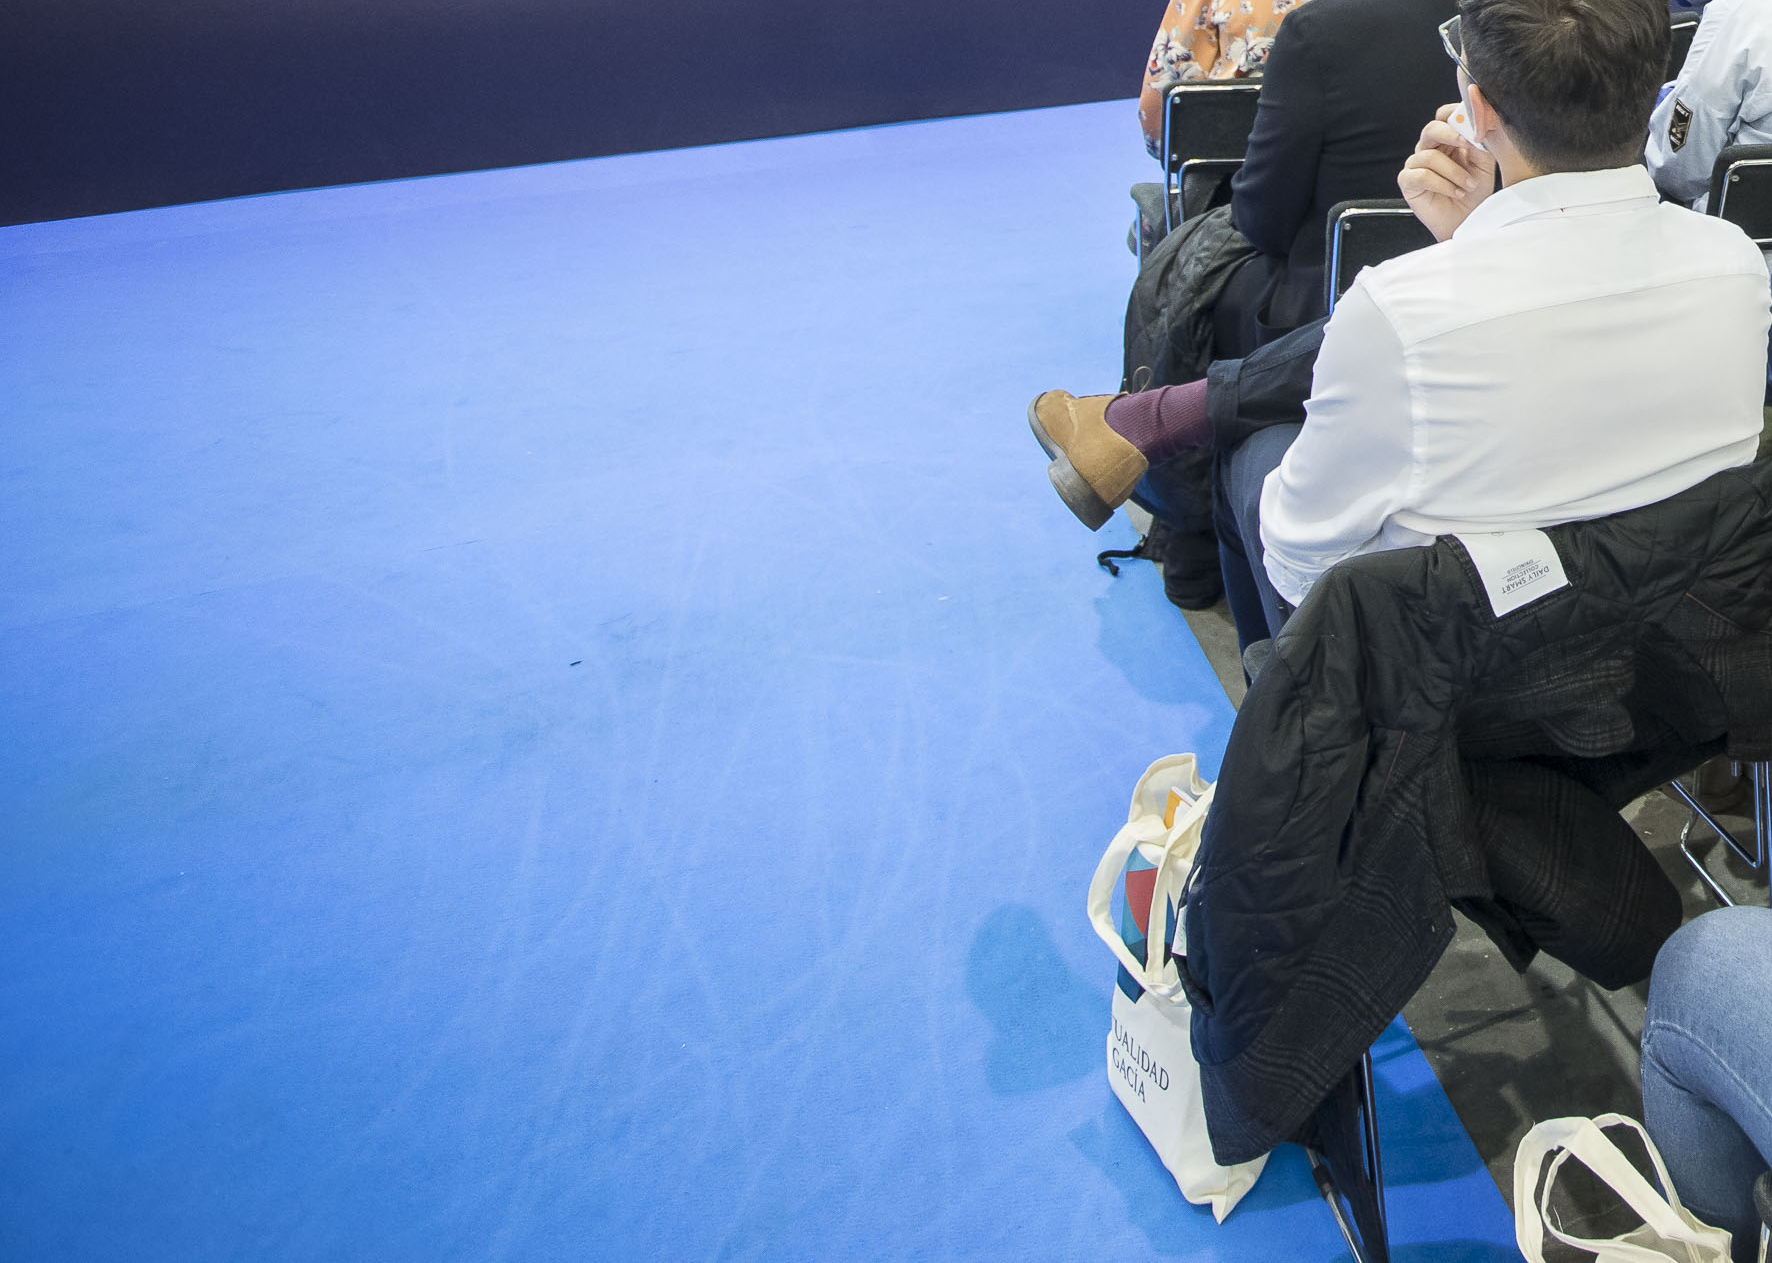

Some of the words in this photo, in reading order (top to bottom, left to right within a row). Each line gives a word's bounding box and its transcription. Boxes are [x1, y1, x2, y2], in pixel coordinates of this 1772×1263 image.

[1528, 566, 1549, 580] DAILY
[1501, 577, 1527, 594] SMART
[1113, 1016, 1170, 1091] UALIDAD
